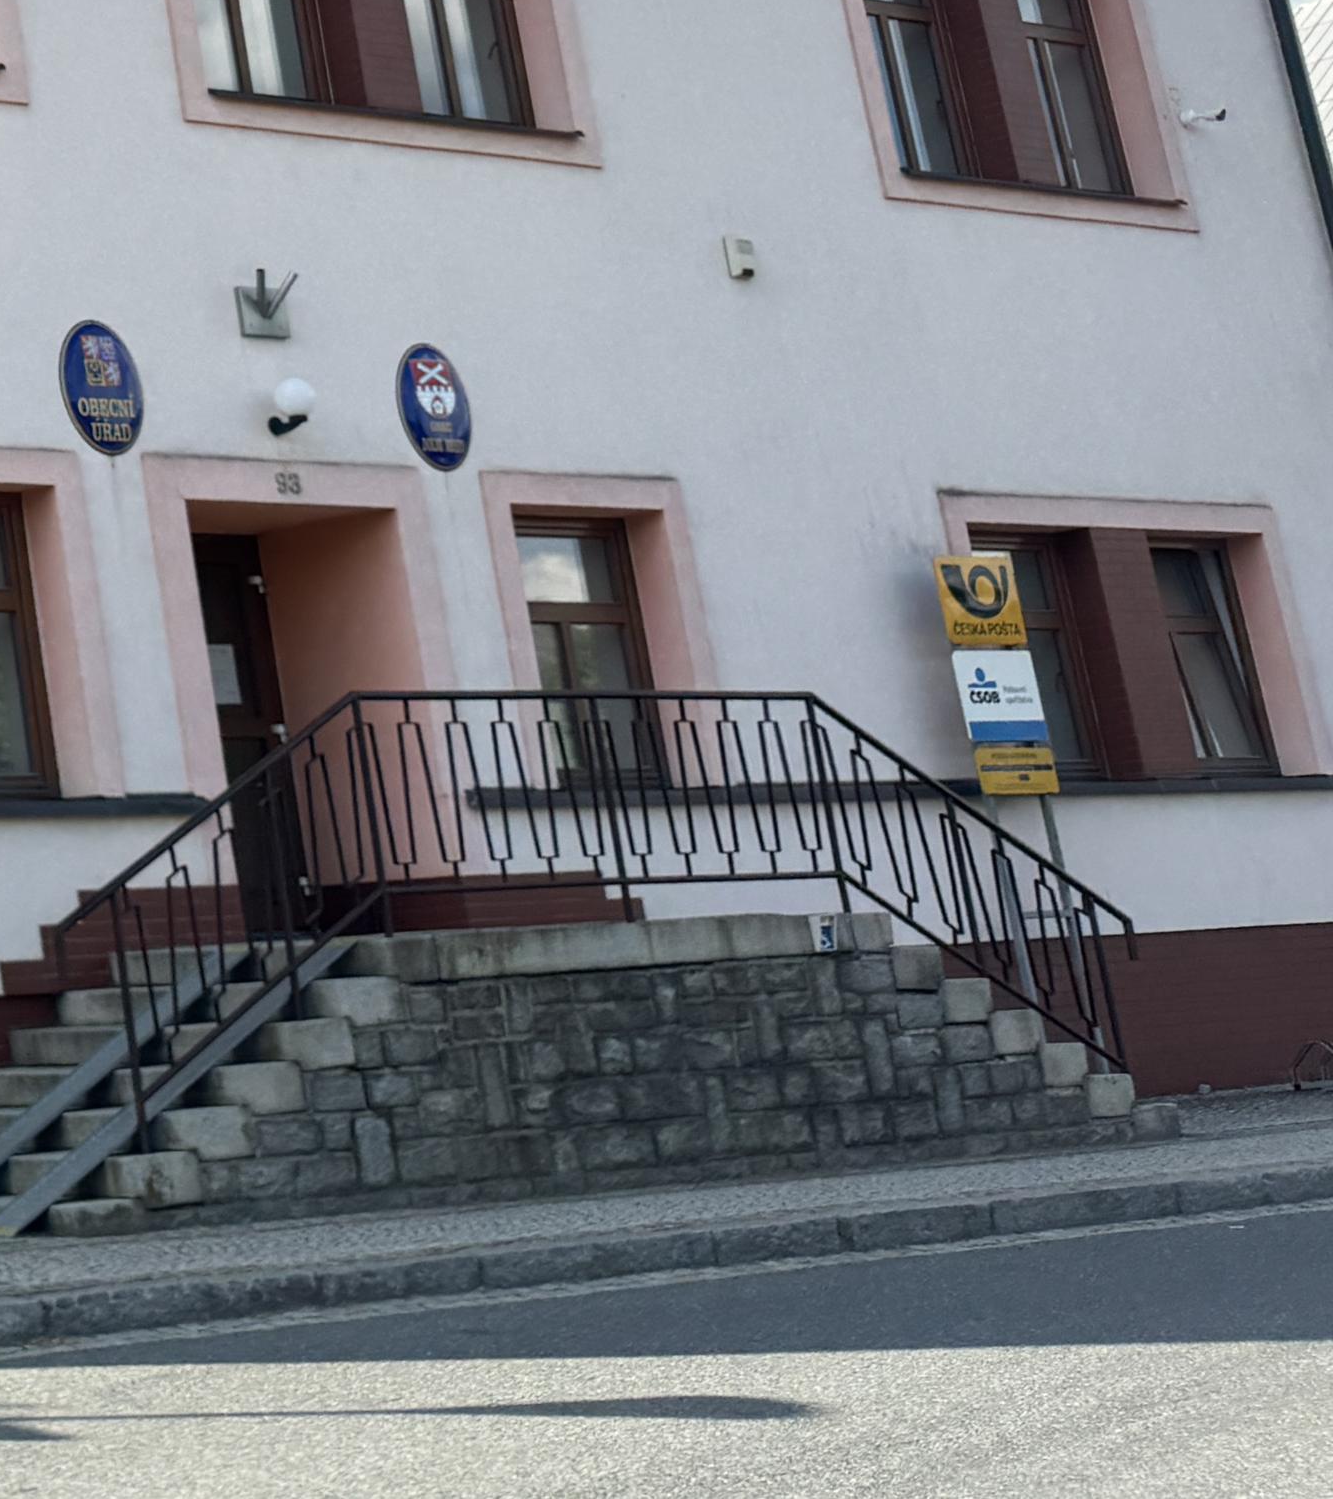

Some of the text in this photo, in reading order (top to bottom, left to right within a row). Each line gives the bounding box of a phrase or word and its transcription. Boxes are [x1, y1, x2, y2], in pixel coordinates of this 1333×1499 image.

[77, 393, 136, 418] OBECNÍ
[90, 417, 132, 442] ÚŘAD
[275, 472, 302, 494] 93
[988, 620, 1020, 636] POŠTA
